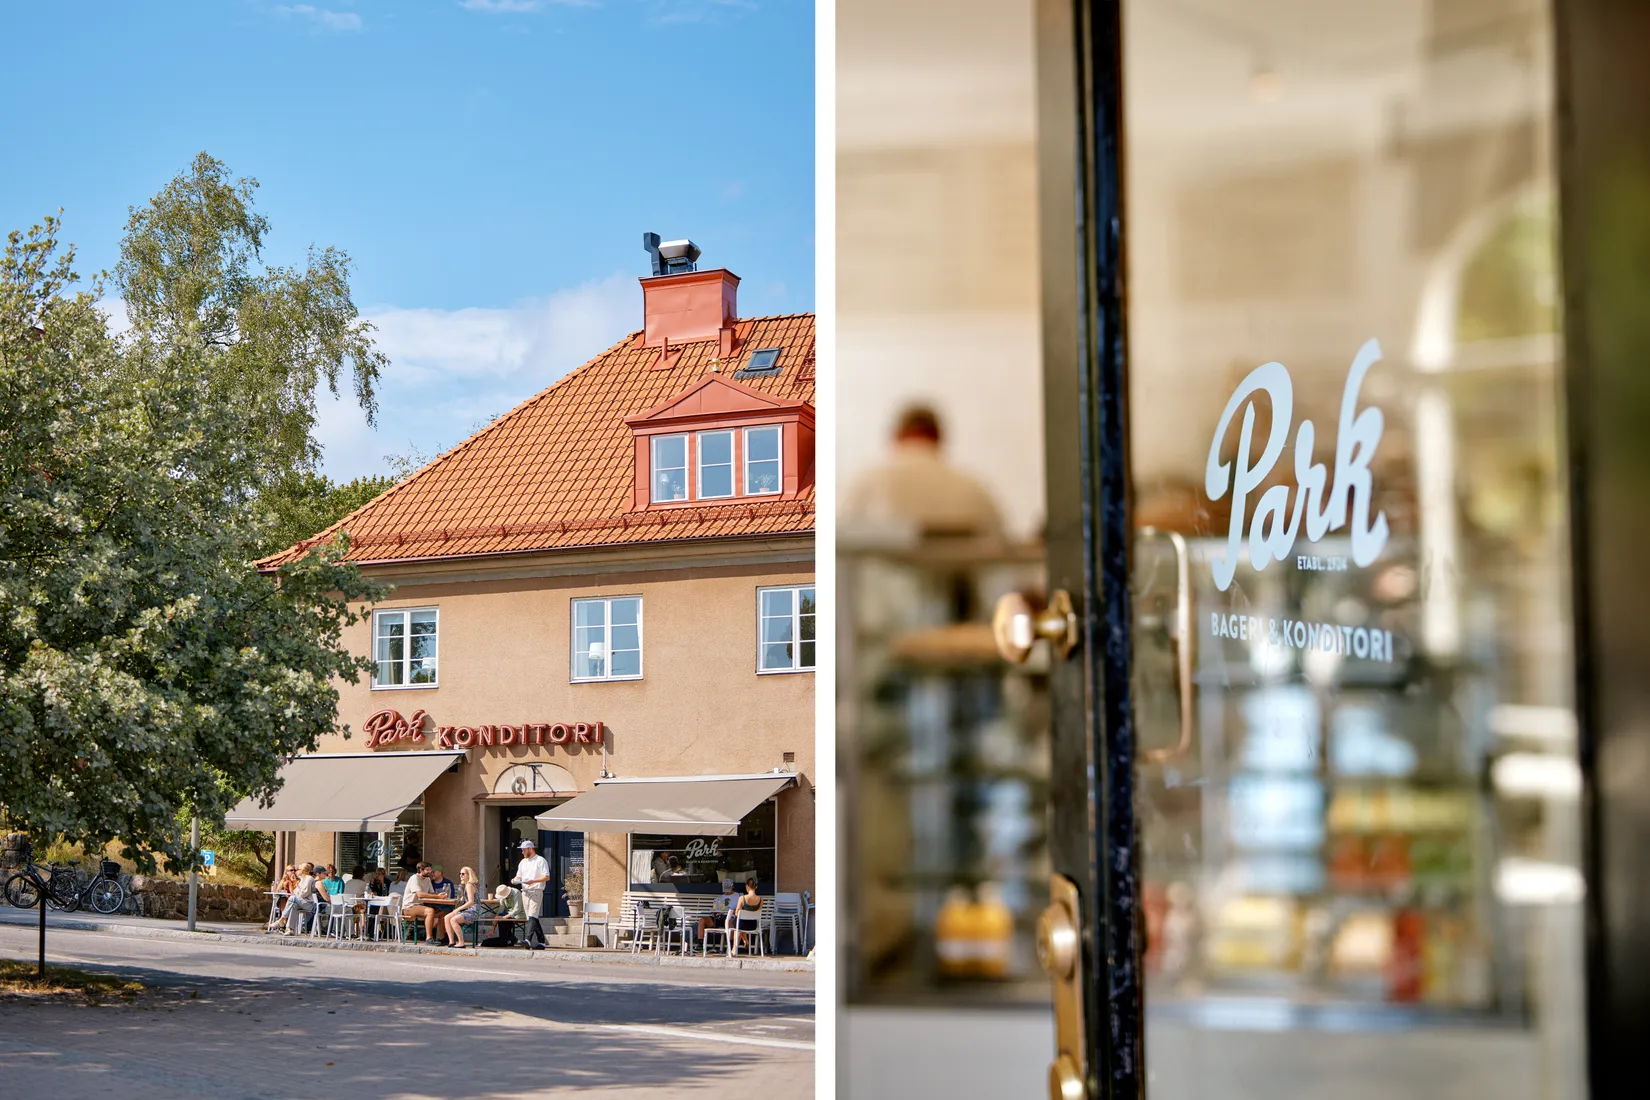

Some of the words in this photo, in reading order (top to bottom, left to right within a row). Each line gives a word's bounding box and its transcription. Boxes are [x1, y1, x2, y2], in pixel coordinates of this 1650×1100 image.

[1205, 337, 1390, 592] Park
[1297, 555, 1326, 571] ETABL.
[1211, 612, 1263, 642] BAGERI
[1268, 618, 1280, 646] &
[1283, 619, 1393, 664] KONDITORI
[362, 709, 426, 748] Park
[437, 721, 604, 748] KONDITORI
[686, 838, 719, 859] Park
